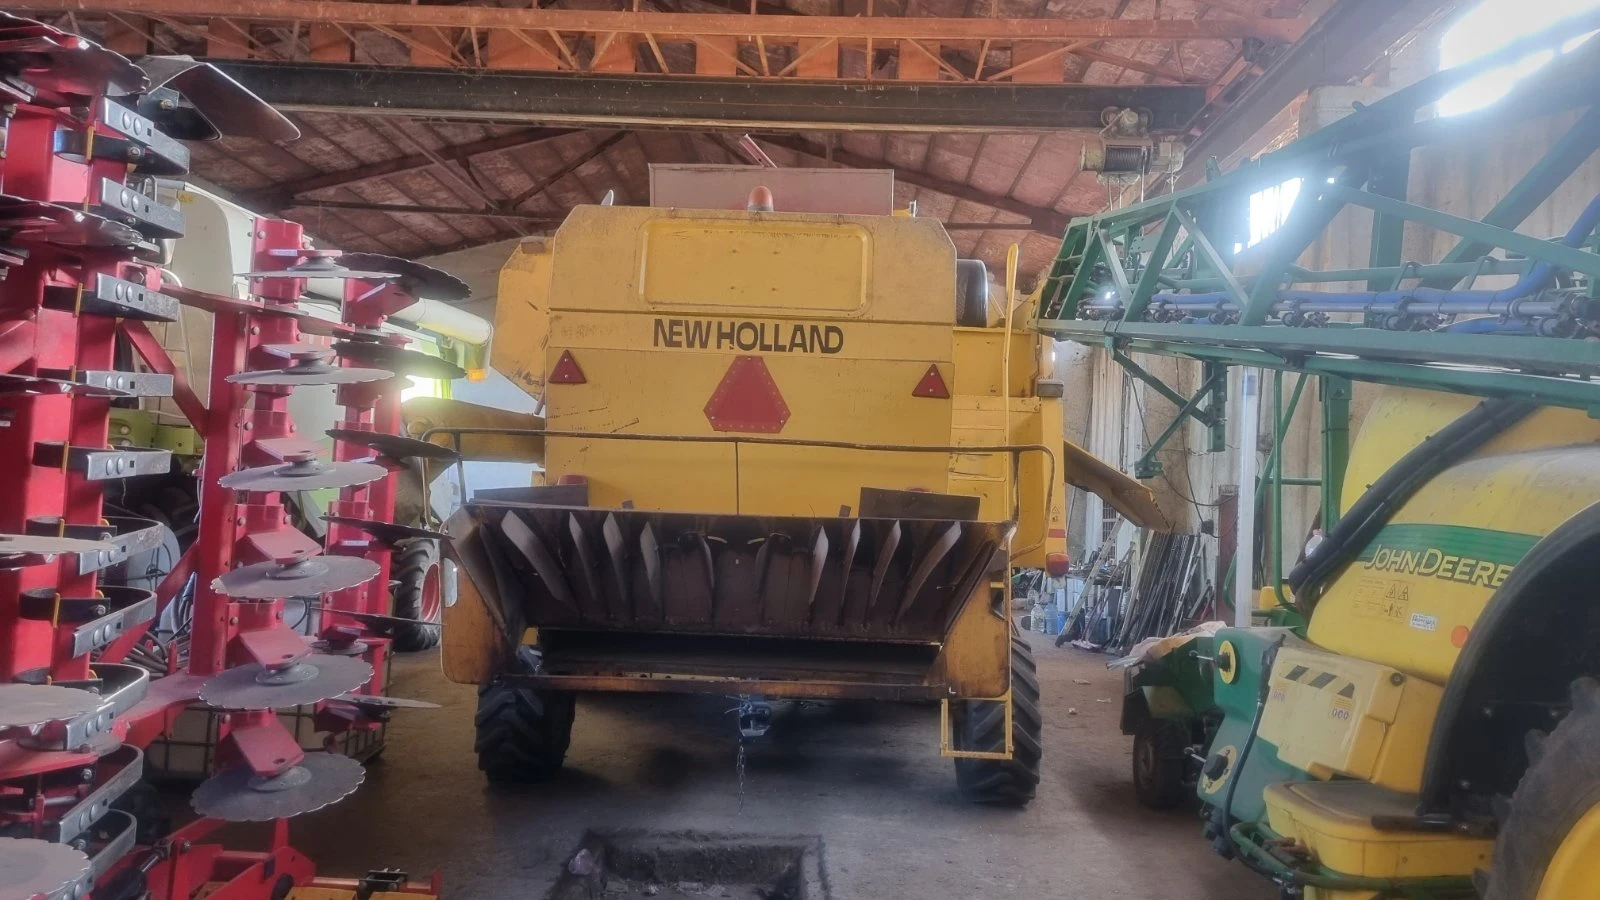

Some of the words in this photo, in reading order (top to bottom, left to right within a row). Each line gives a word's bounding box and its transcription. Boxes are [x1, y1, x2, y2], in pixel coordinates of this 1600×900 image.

[653, 318, 712, 348] NEW
[716, 321, 844, 354] HOLLAND
[1364, 544, 1420, 574] JOHN
[1418, 548, 1514, 588] DEERE
